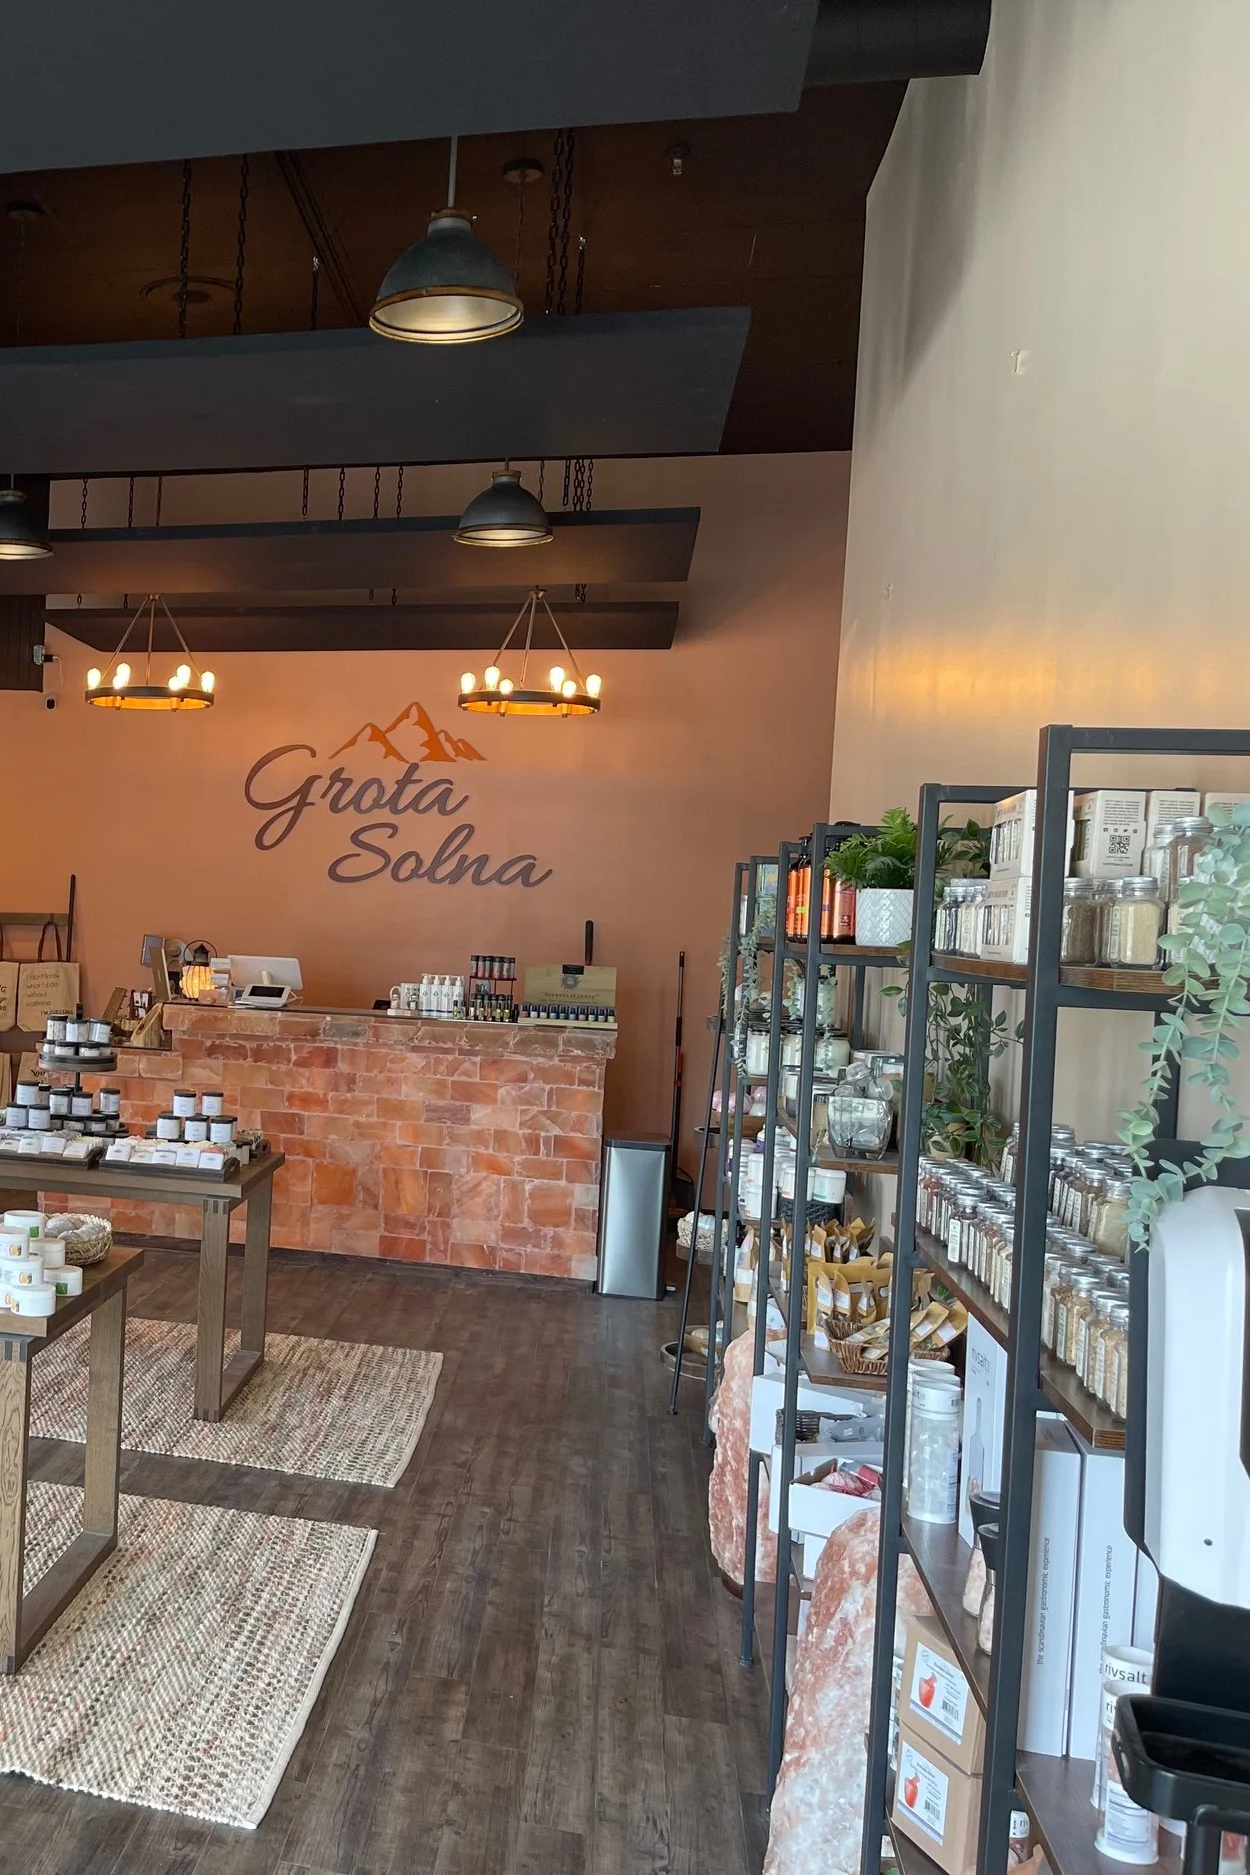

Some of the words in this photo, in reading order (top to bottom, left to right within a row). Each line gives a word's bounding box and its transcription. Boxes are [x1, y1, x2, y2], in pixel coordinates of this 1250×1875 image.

[244, 743, 470, 851] Grota
[328, 822, 553, 888] Solna
[1042, 1537, 1050, 1570] experience
[1105, 1545, 1113, 1579] experience
[1040, 1572, 1049, 1610] gastronomic
[1101, 1581, 1111, 1620] gastronomic
[1036, 1612, 1047, 1653] scandinavian
[1036, 1655, 1044, 1665] the
[1105, 1662, 1147, 1685] rivsalt
